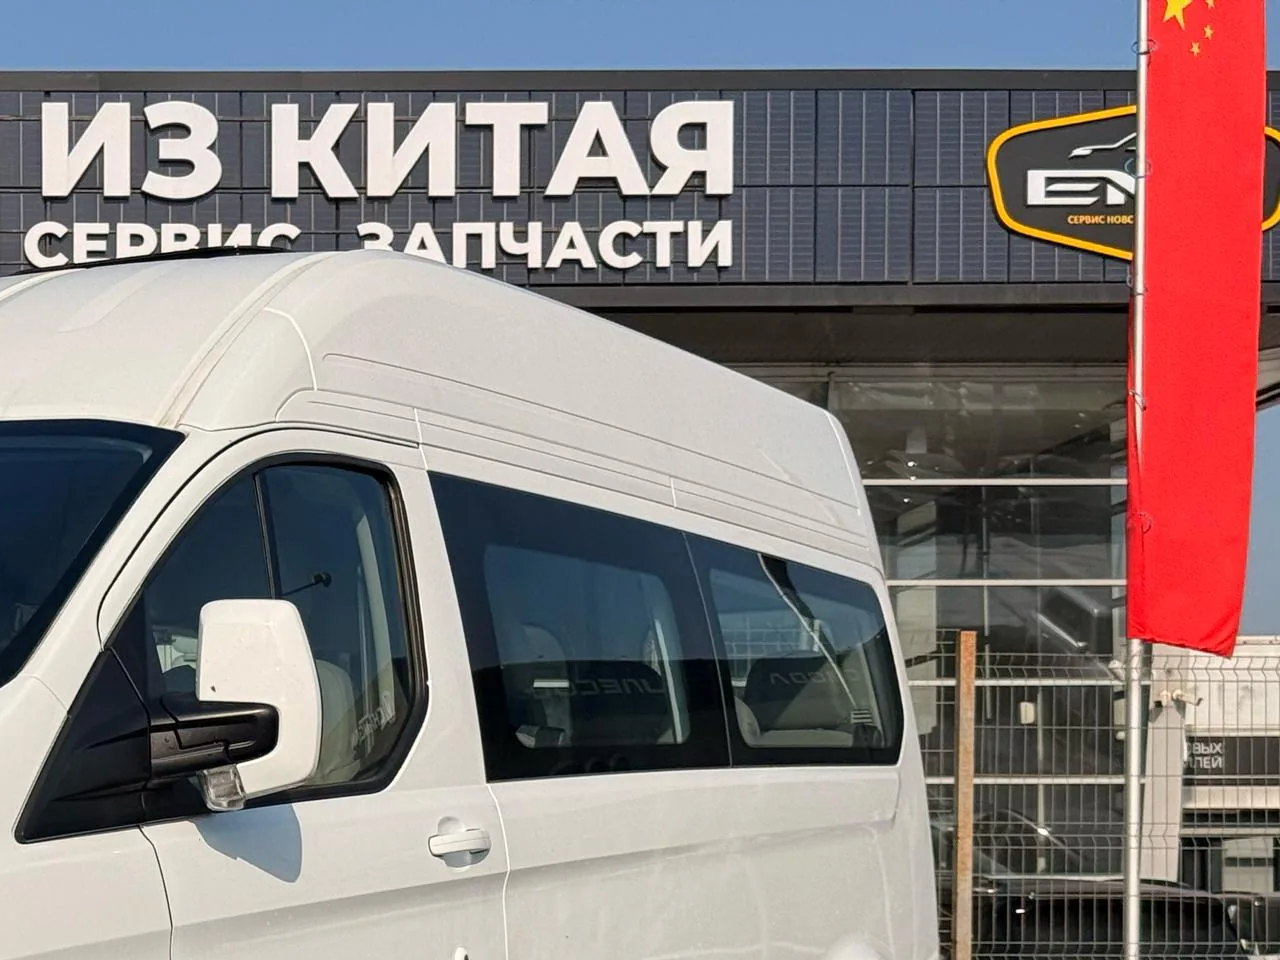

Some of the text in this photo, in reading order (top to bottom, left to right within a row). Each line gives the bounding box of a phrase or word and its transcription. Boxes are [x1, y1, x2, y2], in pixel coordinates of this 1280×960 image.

[40, 100, 223, 200] ИЗ
[271, 100, 735, 200] КИТАЯ
[356, 218, 734, 270] ЗАПЧАСТИ
[1067, 214, 1106, 225] СЕРВИС
